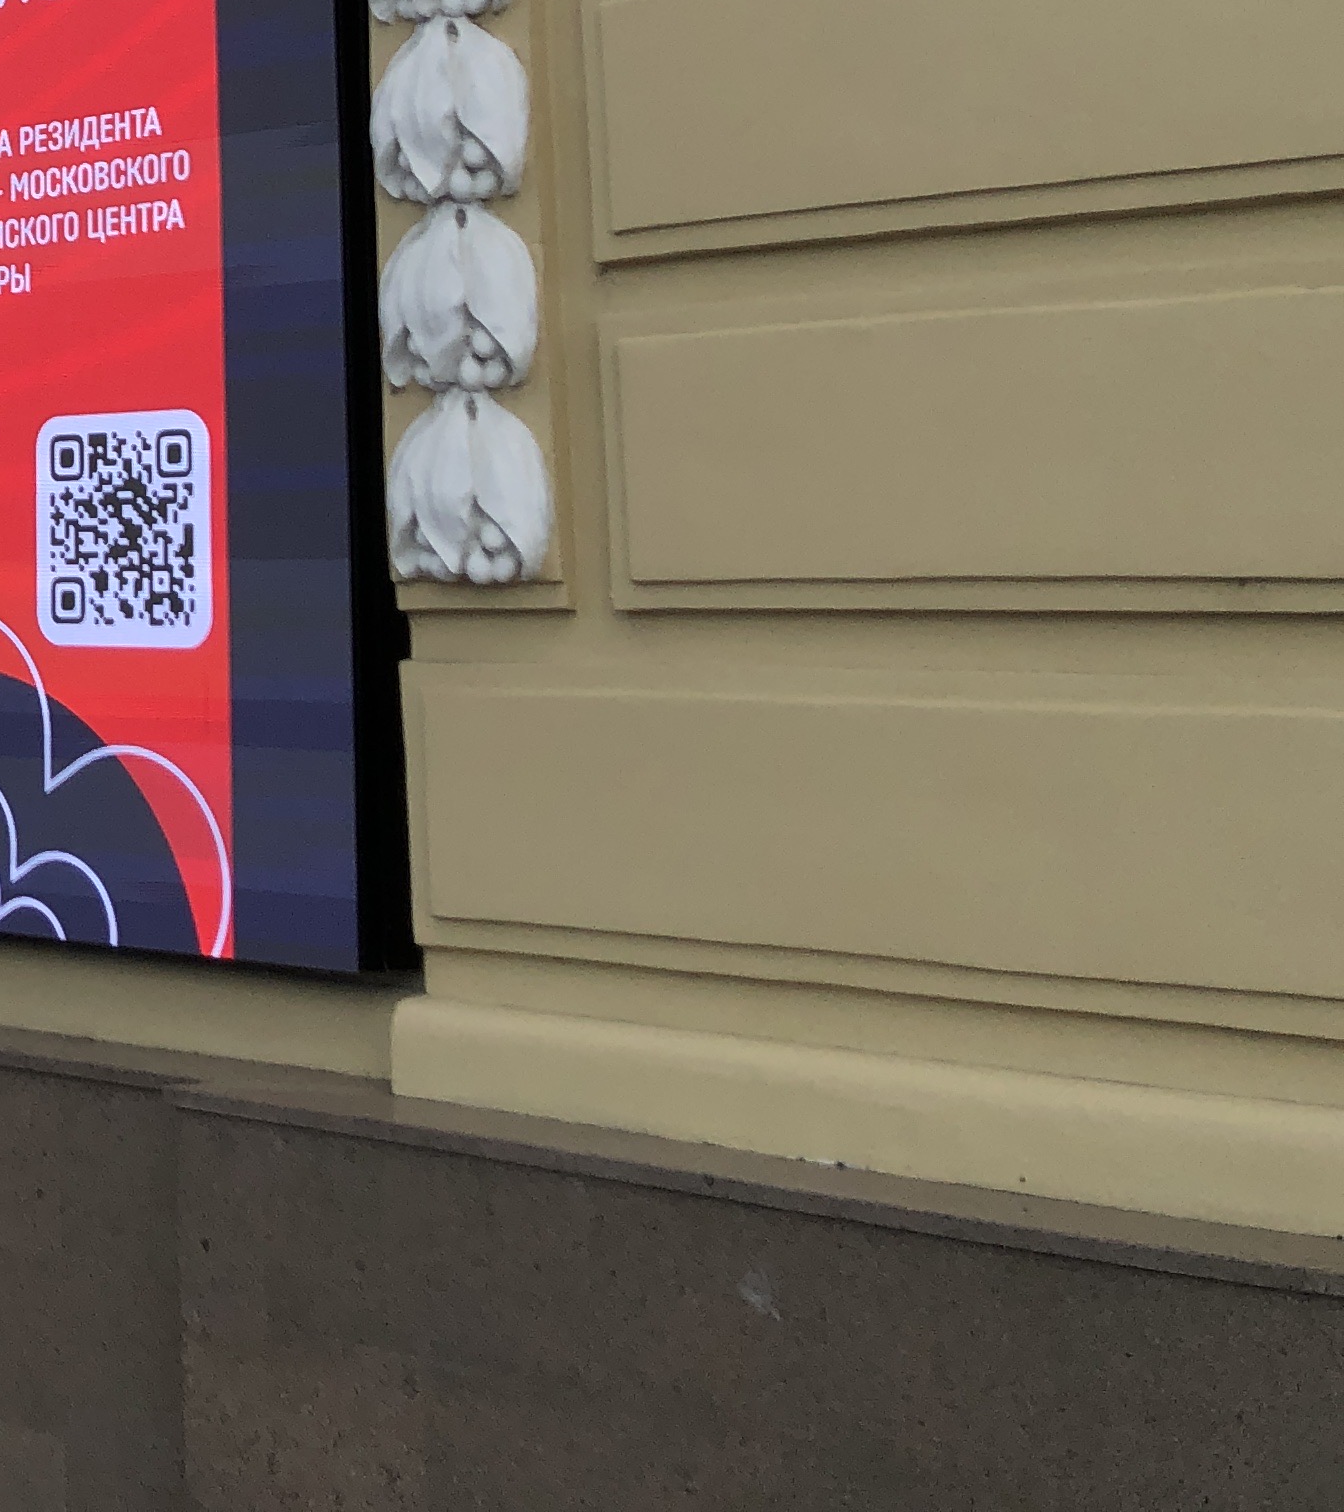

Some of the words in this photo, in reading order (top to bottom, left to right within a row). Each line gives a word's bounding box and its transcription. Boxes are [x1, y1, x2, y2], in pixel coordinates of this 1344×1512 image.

[19, 106, 162, 155] РЕЗИДЕНТА
[10, 149, 190, 202] МОСКОВСКОГО
[86, 199, 185, 244] ЦЕНТРА
